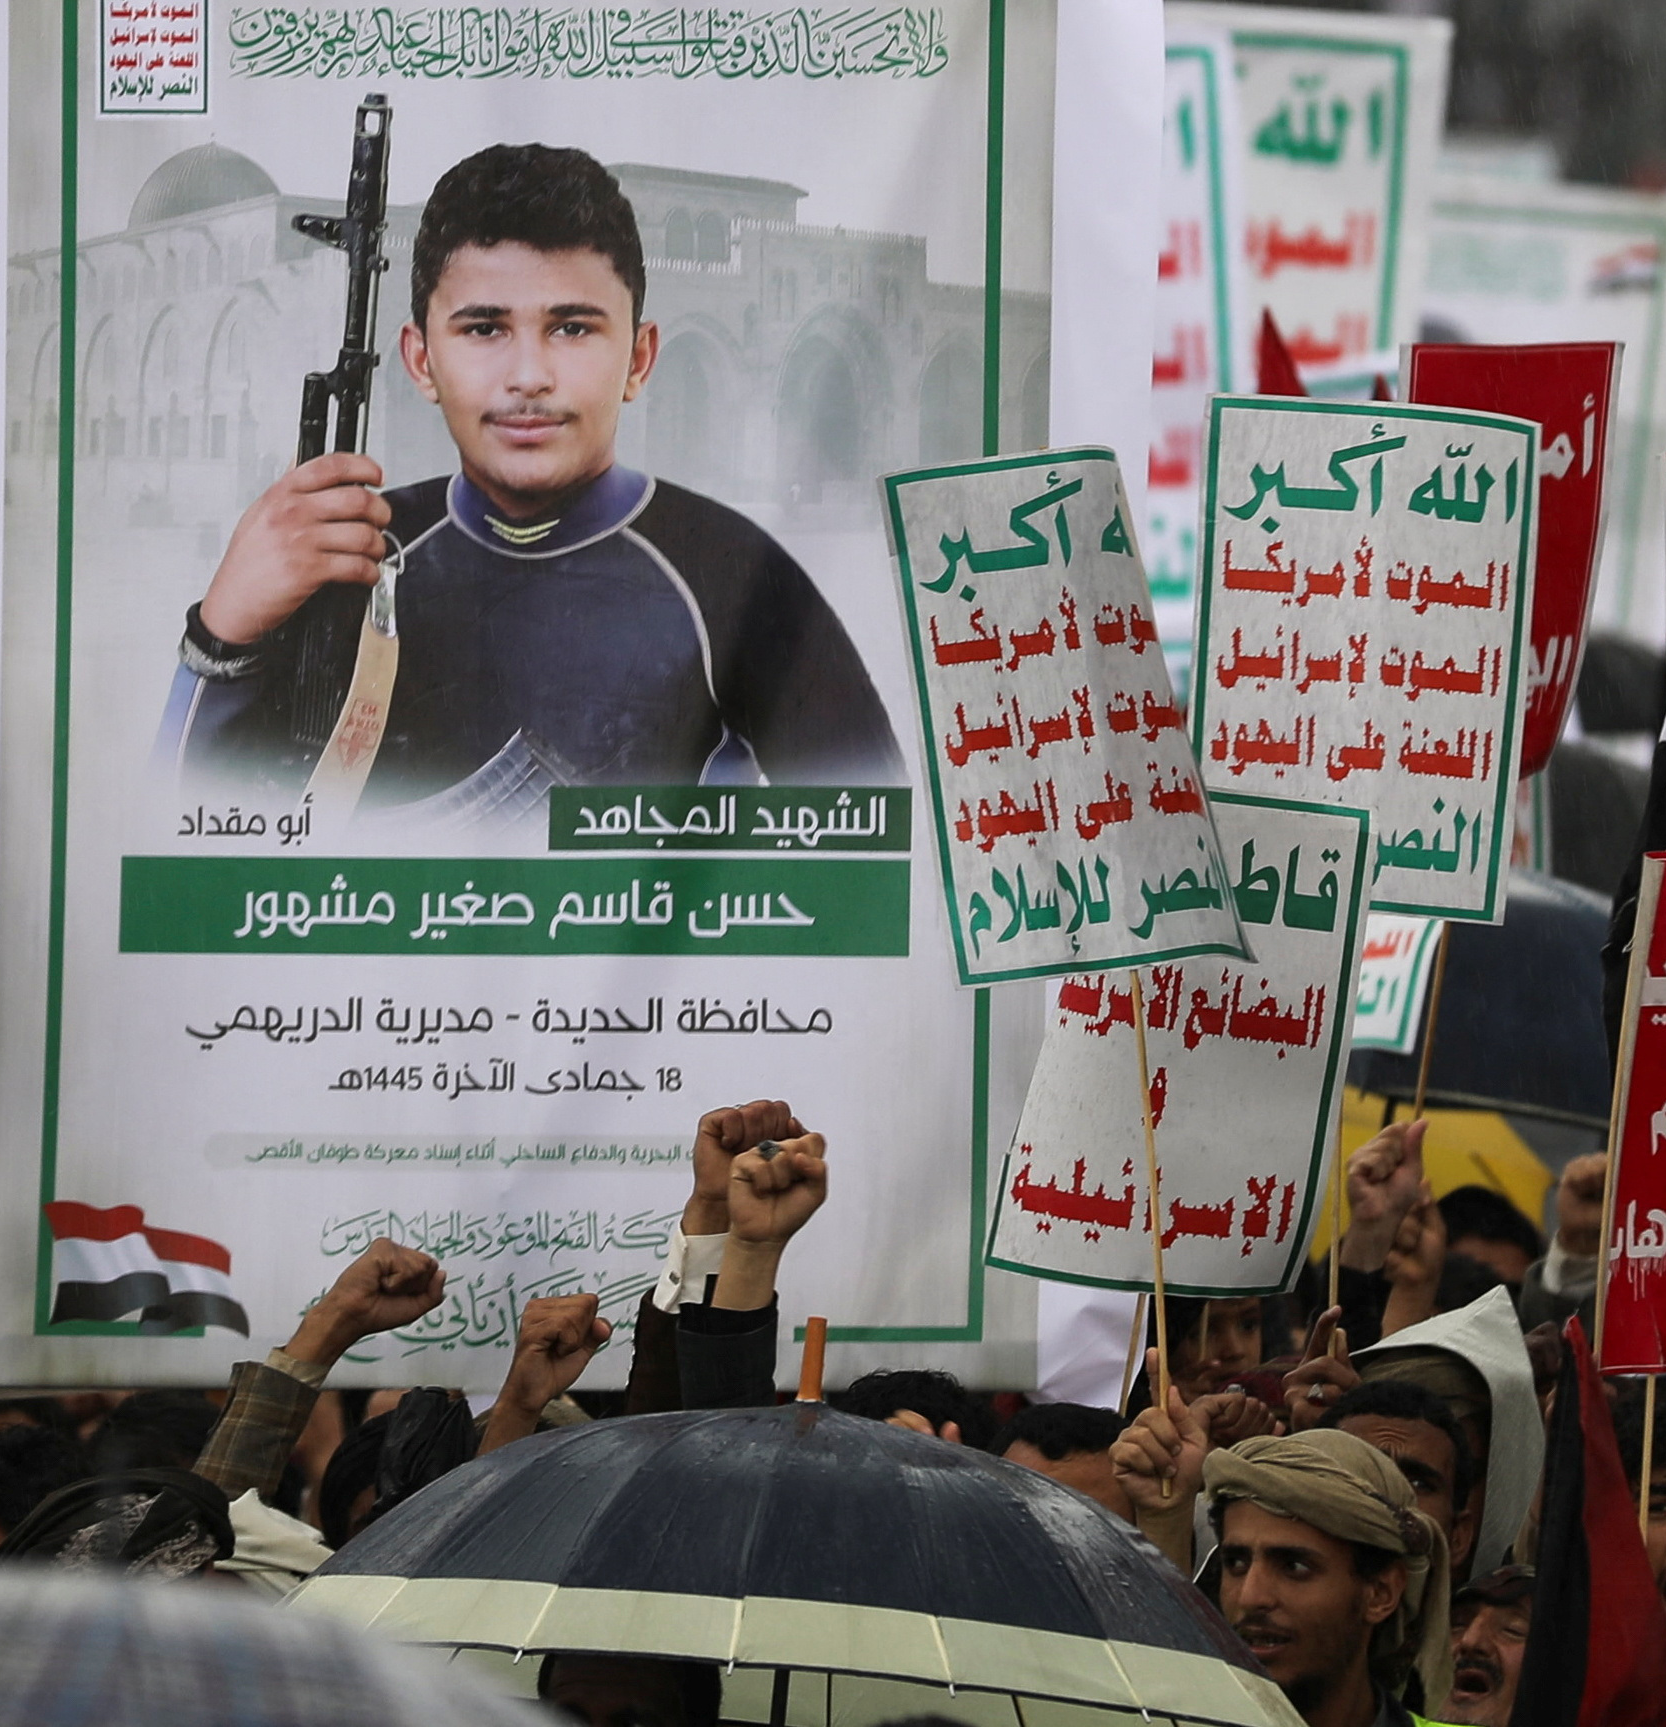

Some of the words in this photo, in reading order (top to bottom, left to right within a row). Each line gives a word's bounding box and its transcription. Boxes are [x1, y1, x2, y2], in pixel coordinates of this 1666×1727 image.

[160, 27, 198, 47] الموت
[161, 3, 199, 22] الموت
[1224, 423, 1408, 534] أكبر
[1407, 446, 1519, 524] الله
[920, 470, 1084, 603] أكبر
[1222, 536, 1375, 608] لأمريكا
[1384, 560, 1511, 616] الموت
[928, 585, 1083, 673] لأمريكا
[1215, 625, 1369, 699] لإسرائيل
[1378, 645, 1503, 703] الموت
[944, 684, 1097, 769] لإسرائيل
[1209, 715, 1317, 778] اليهود
[1325, 719, 1387, 783] على
[1397, 720, 1494, 782] اللعنة
[175, 803, 267, 839] مقداد
[275, 791, 315, 847] أبو
[572, 794, 739, 848] المجاهد
[750, 789, 889, 850] الشهيد
[953, 778, 1061, 854] اليهود
[1073, 771, 1135, 842] على
[233, 874, 397, 940] مشهور
[409, 881, 535, 941] صغير
[549, 878, 674, 942] قاسم
[687, 888, 817, 939] حسن
[968, 857, 1112, 955] للإسلام
[184, 996, 362, 1053] الدريهمي
[375, 997, 494, 1046] مديرية
[531, 996, 664, 1046] الحديدة
[675, 996, 834, 1036] محافظة
[1181, 968, 1327, 1060] البضائع
[433, 1058, 517, 1098] الآخرة
[524, 1066, 645, 1101] جمادى
[655, 1067, 684, 1093] 18
[306, 1141, 360, 1164] طوفان
[364, 1143, 419, 1163] معركة
[422, 1144, 462, 1167] إسناد
[465, 1136, 495, 1162] أثناء
[499, 1143, 566, 1168] الساحلي
[570, 1144, 626, 1166] والدفاع
[630, 1144, 681, 1167] البحرية
[1010, 1144, 1296, 1258] الإسرائيلية
